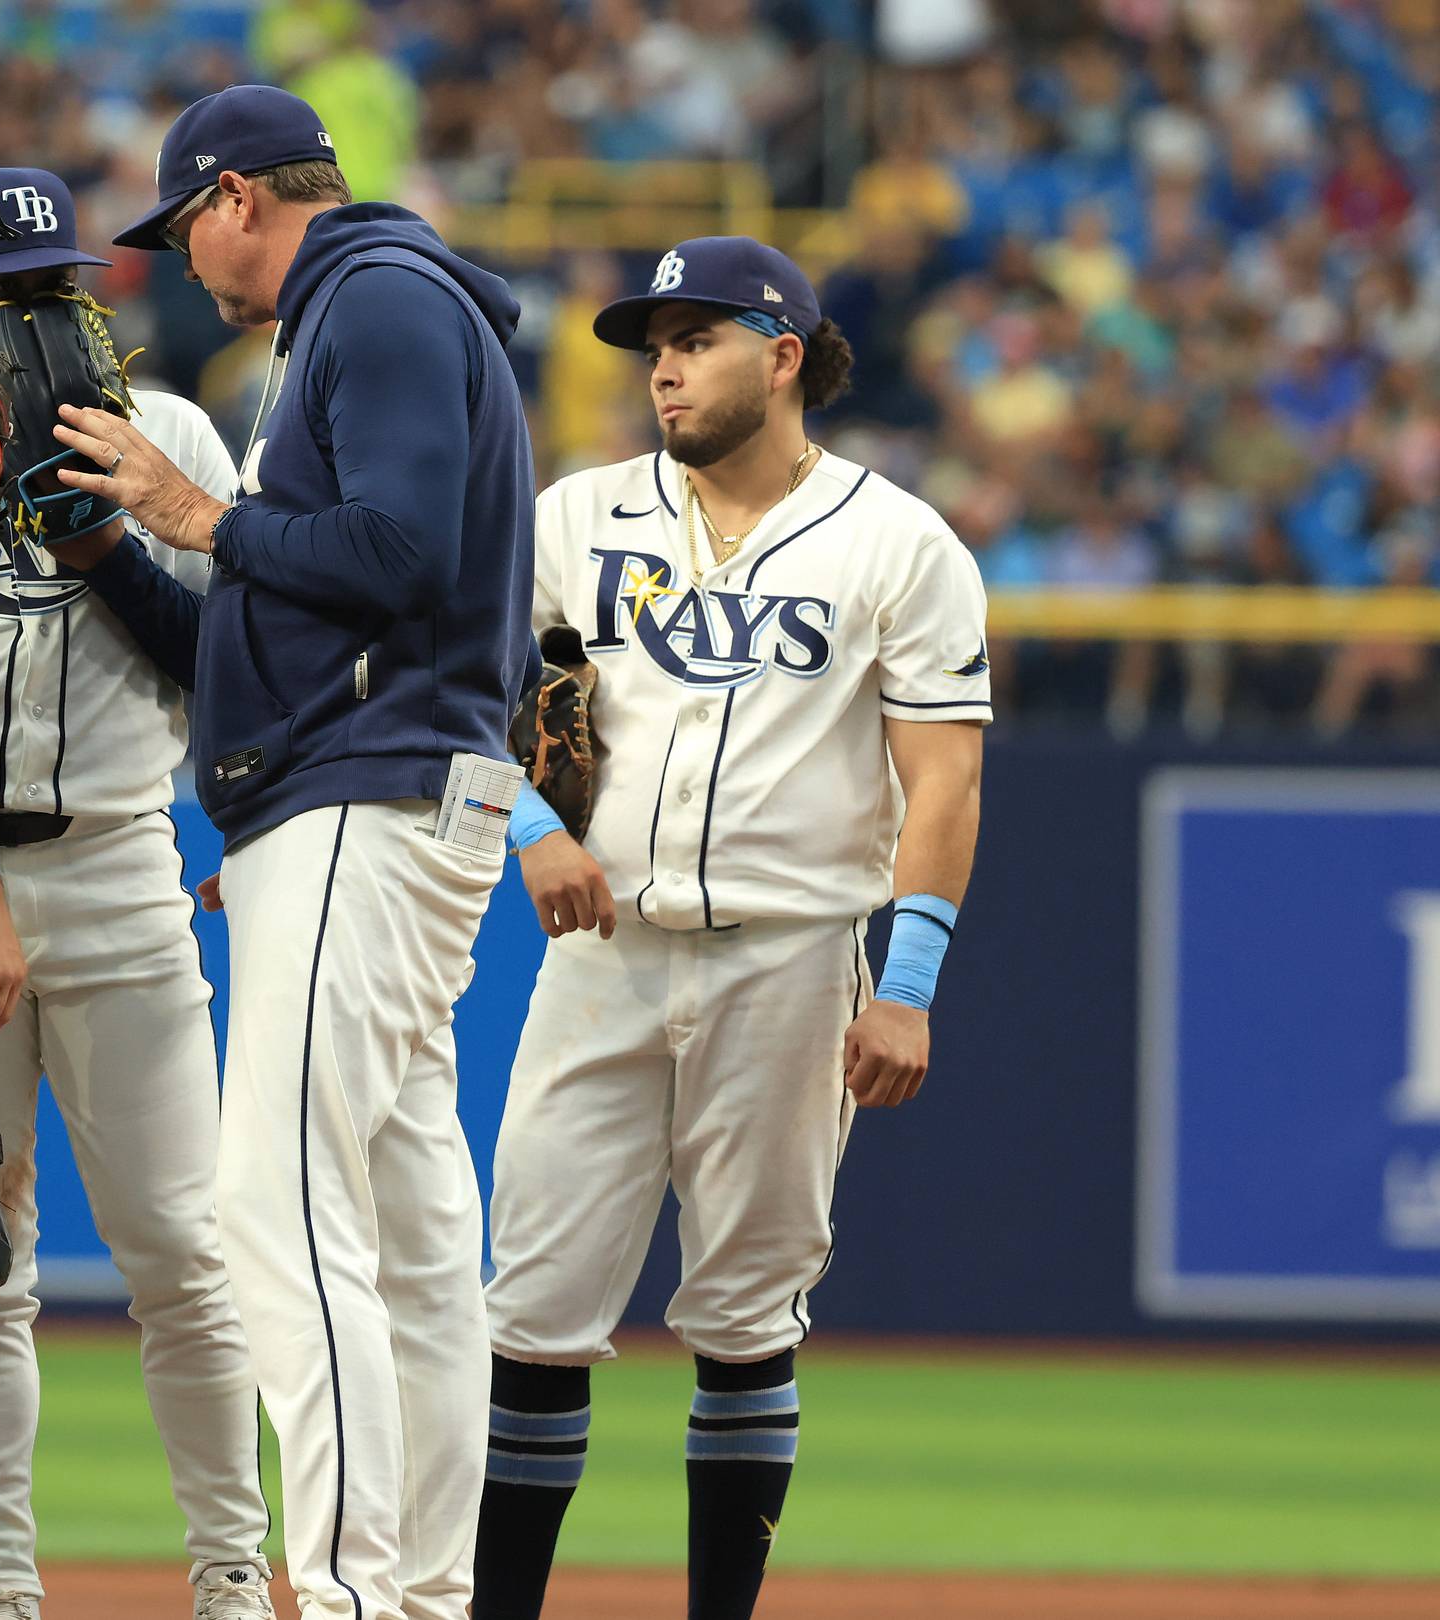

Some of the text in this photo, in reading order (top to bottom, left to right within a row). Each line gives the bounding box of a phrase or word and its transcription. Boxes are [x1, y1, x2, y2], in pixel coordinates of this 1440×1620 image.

[2, 186, 58, 232] TB
[582, 546, 837, 689] RAYS
[225, 1569, 248, 1584] NIKE
